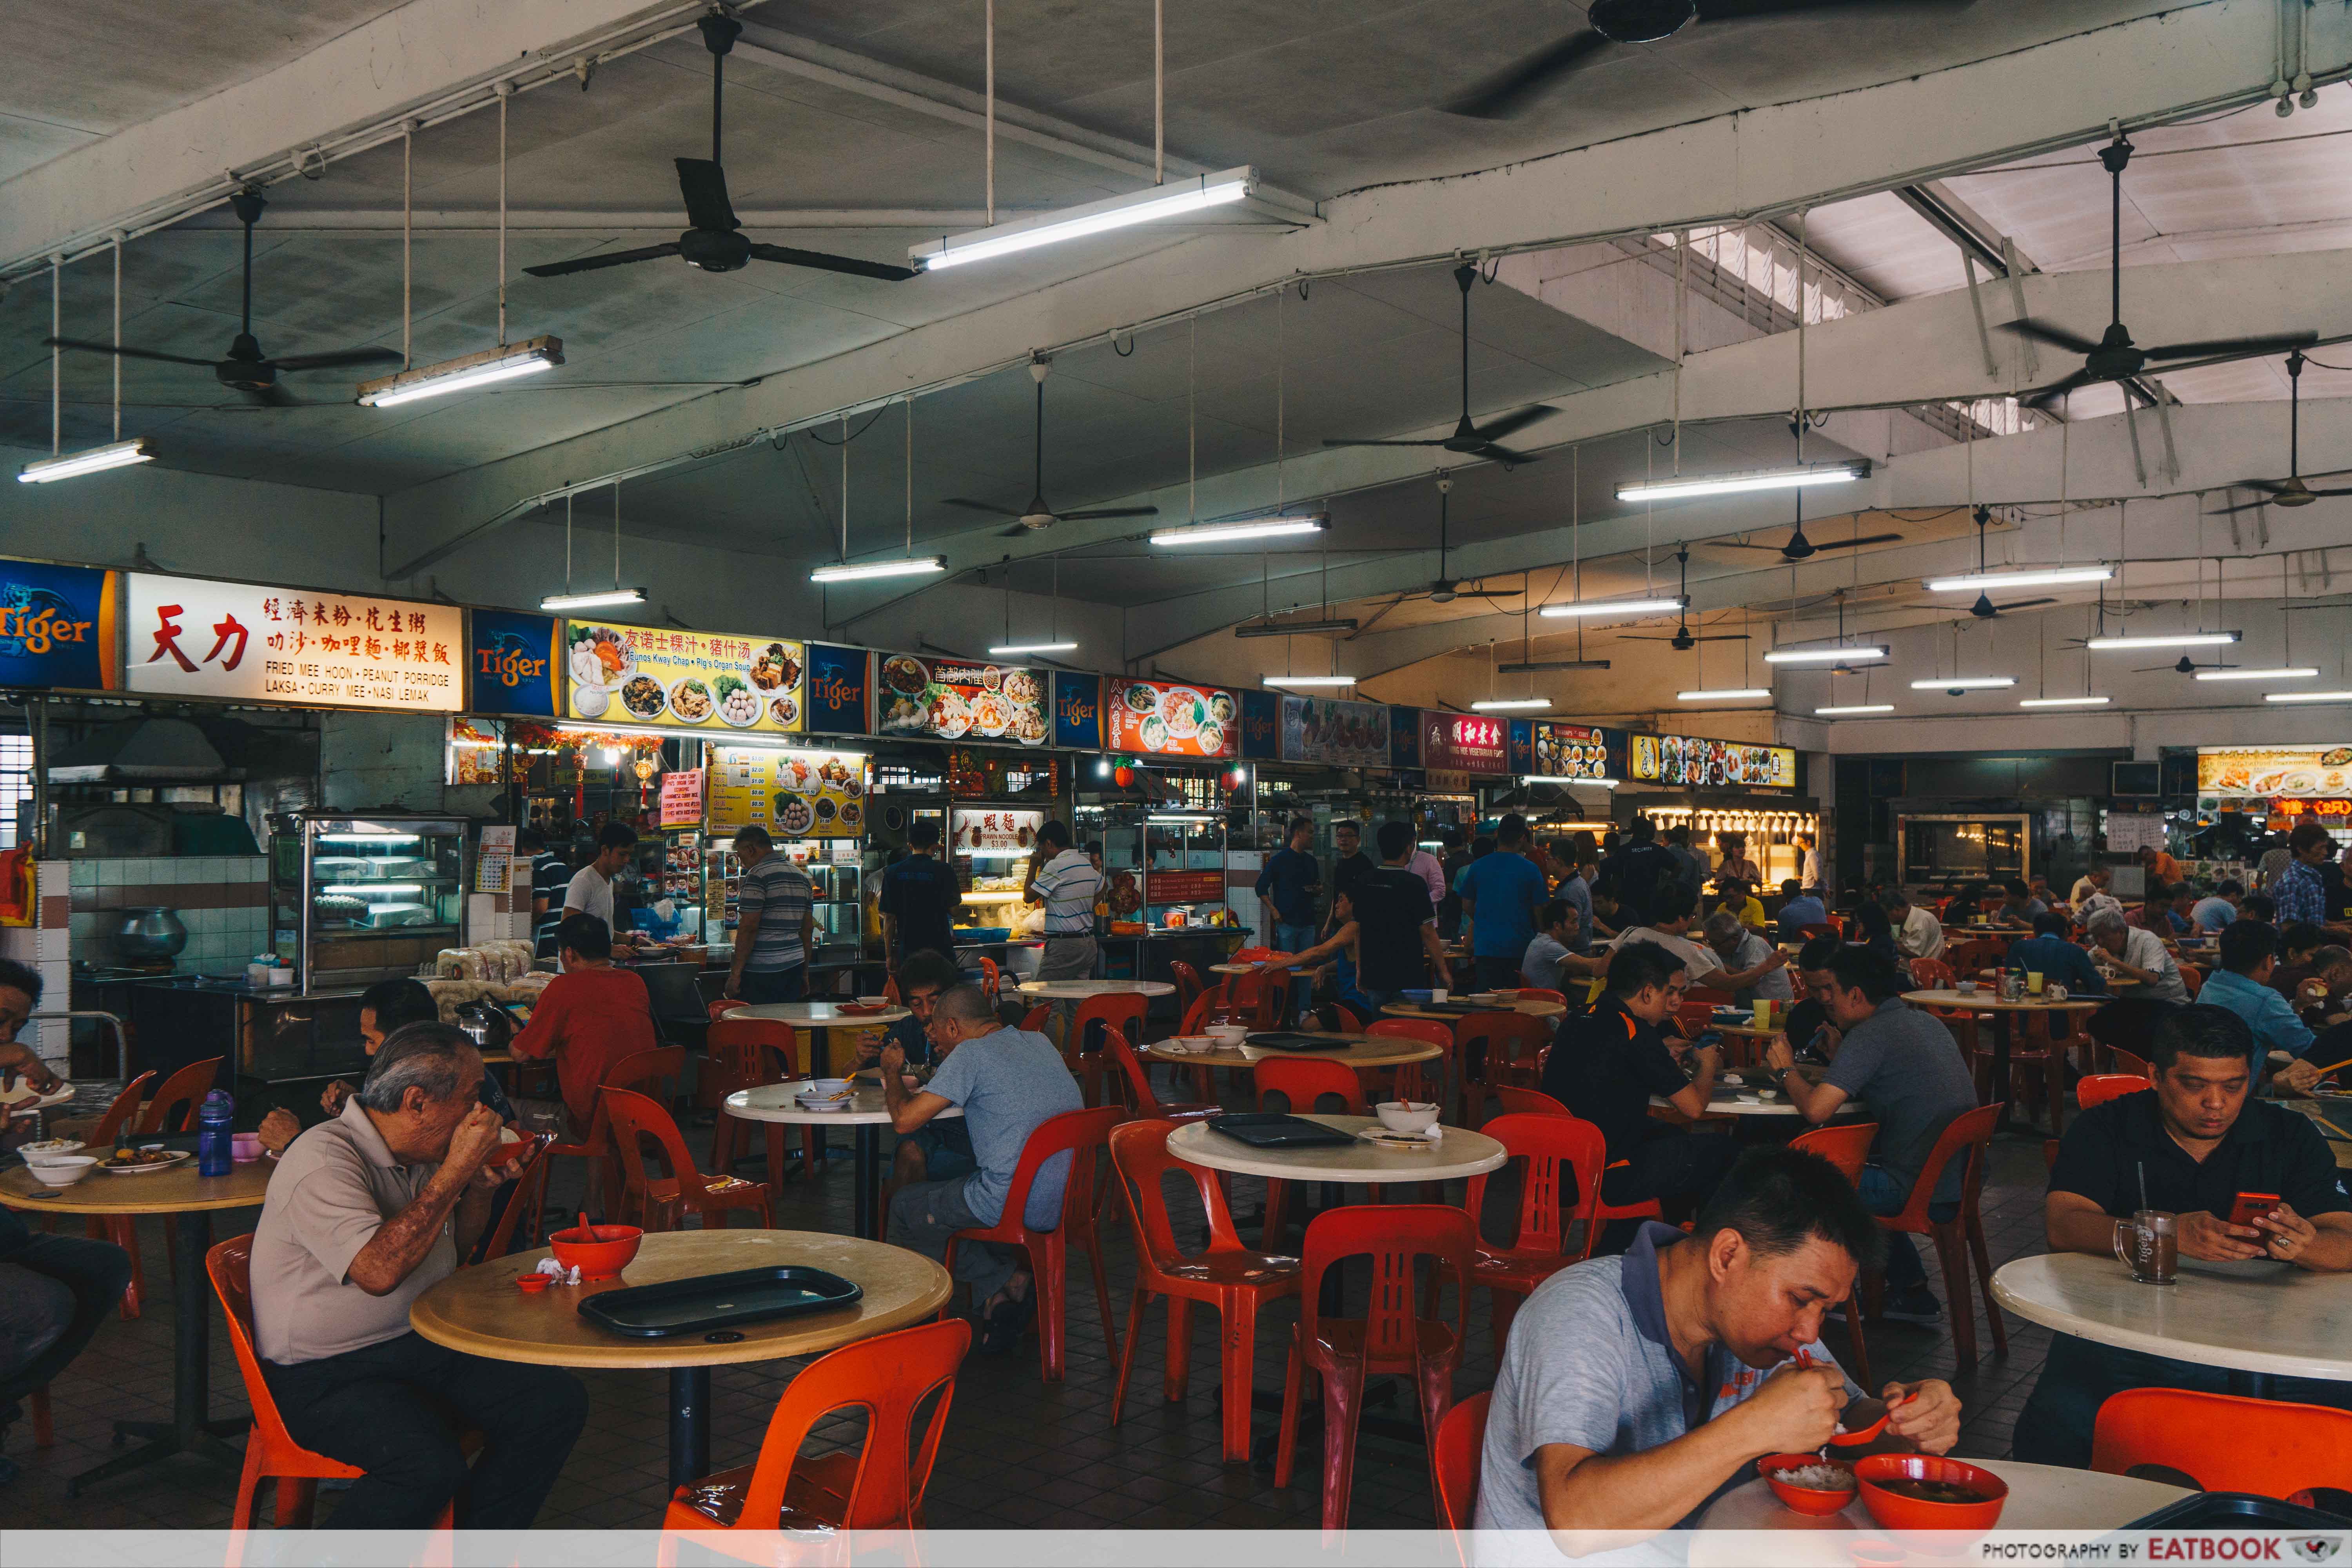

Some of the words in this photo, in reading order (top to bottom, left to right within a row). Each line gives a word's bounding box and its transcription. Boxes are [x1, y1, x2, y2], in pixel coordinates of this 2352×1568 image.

[146, 604, 248, 672] 天力
[266, 661, 294, 675] FRIED
[300, 664, 319, 677] MEE
[325, 666, 352, 679] HOON
[363, 669, 398, 682] PEANUT
[405, 672, 448, 686] PORRIDGE
[477, 648, 546, 686] Tiger
[630, 652, 651, 662] Eunos
[653, 654, 671, 667] Kway
[672, 655, 690, 667] Chap
[714, 659, 733, 671] Organ
[734, 661, 750, 672] Soup
[265, 679, 298, 693] LAKSA
[308, 682, 340, 696] CURRY
[347, 685, 365, 697] MEE
[373, 686, 394, 699] NASI
[399, 689, 429, 702] LEMAK
[811, 677, 861, 710] Tiger
[1057, 697, 1095, 726] Tiger
[1469, 748, 1493, 757] VEGETARIAN
[1494, 750, 1504, 758] FOOD
[1512, 739, 1530, 759] Tiger
[2139, 1235, 2152, 1264] Tiger
